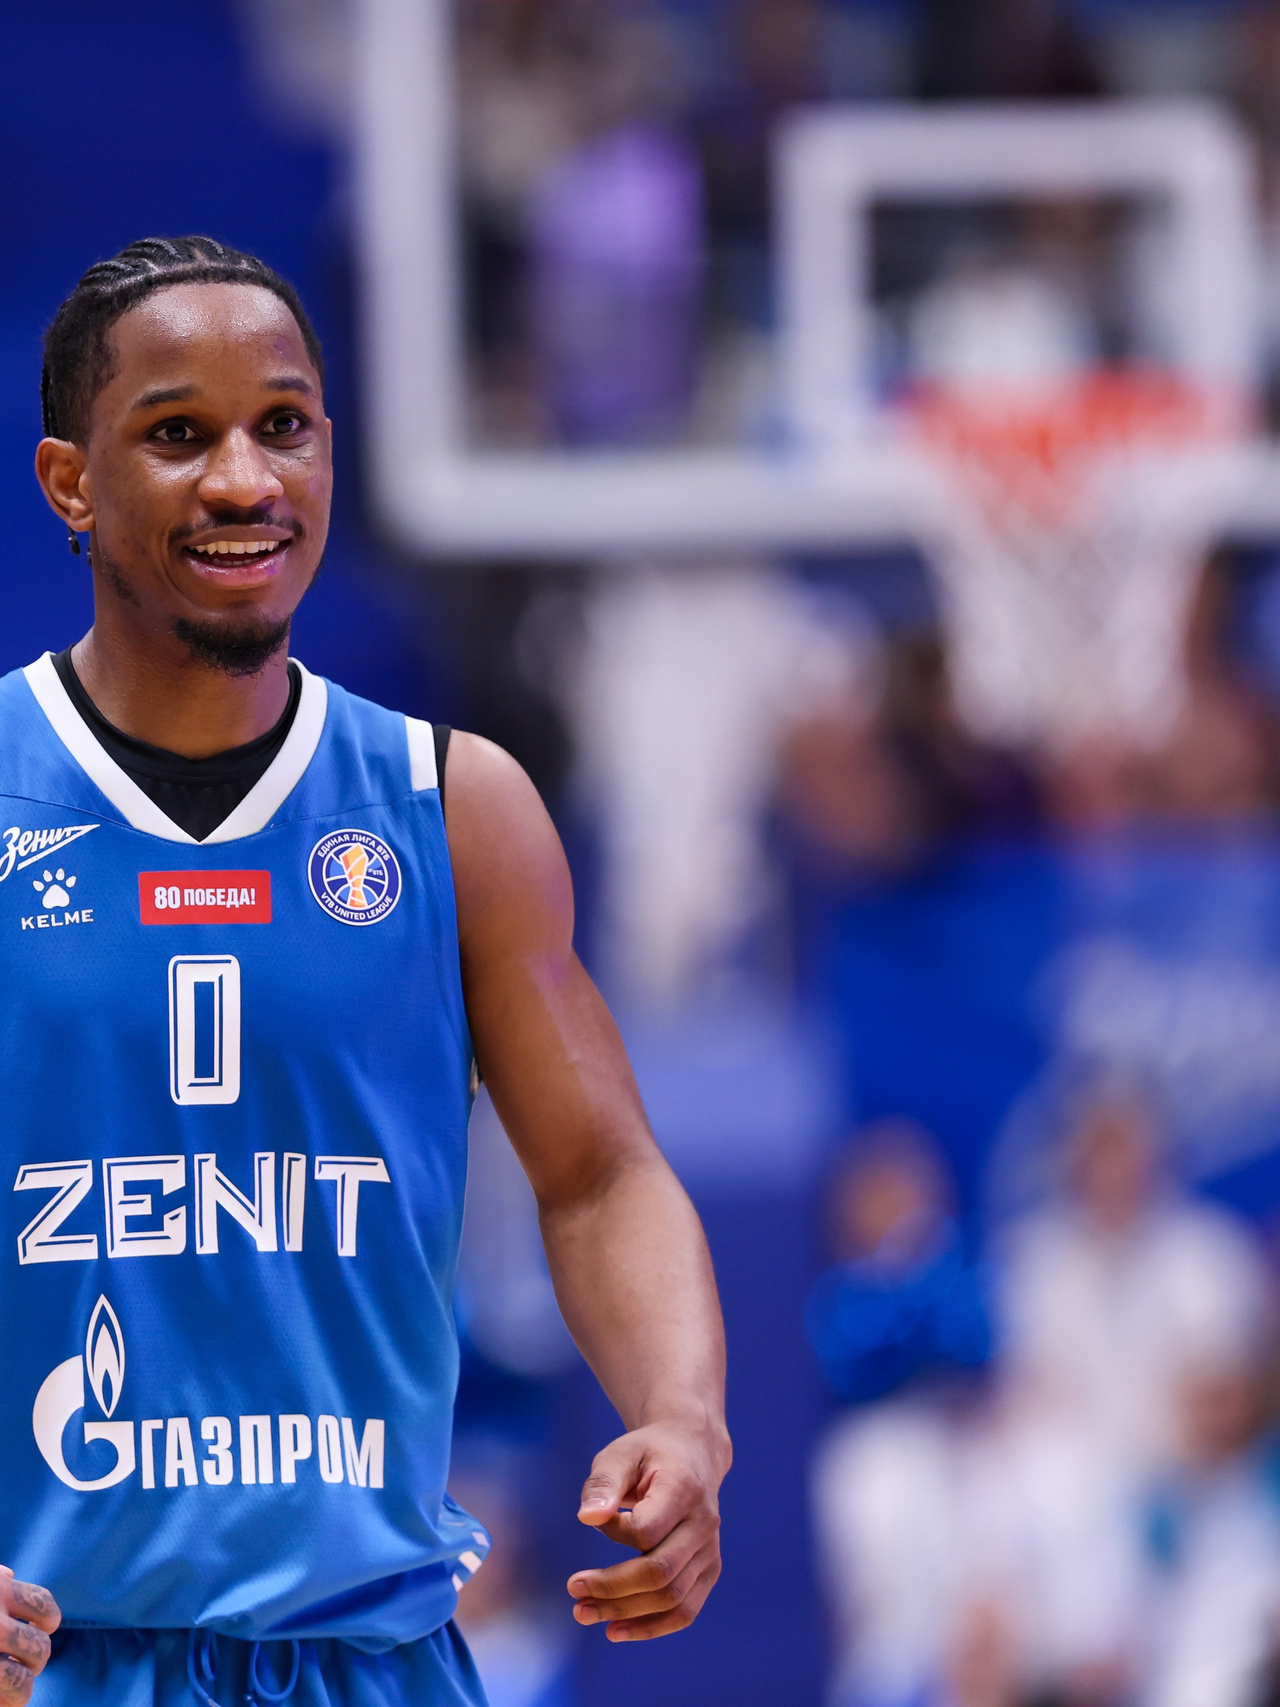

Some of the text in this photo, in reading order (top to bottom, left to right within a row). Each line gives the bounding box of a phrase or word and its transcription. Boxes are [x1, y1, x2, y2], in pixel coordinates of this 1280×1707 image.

[318, 834, 390, 861] ЕДИНАЯ ЛИГА ВТБ
[154, 886, 256, 909] 80 ПОБЕДА!
[321, 892, 393, 920] VTB UNITED LEAGUE
[21, 909, 94, 931] KELME
[168, 954, 241, 1106] 0
[13, 1151, 392, 1266] ZENIT
[141, 1413, 385, 1490] ГАЗПРОМ
